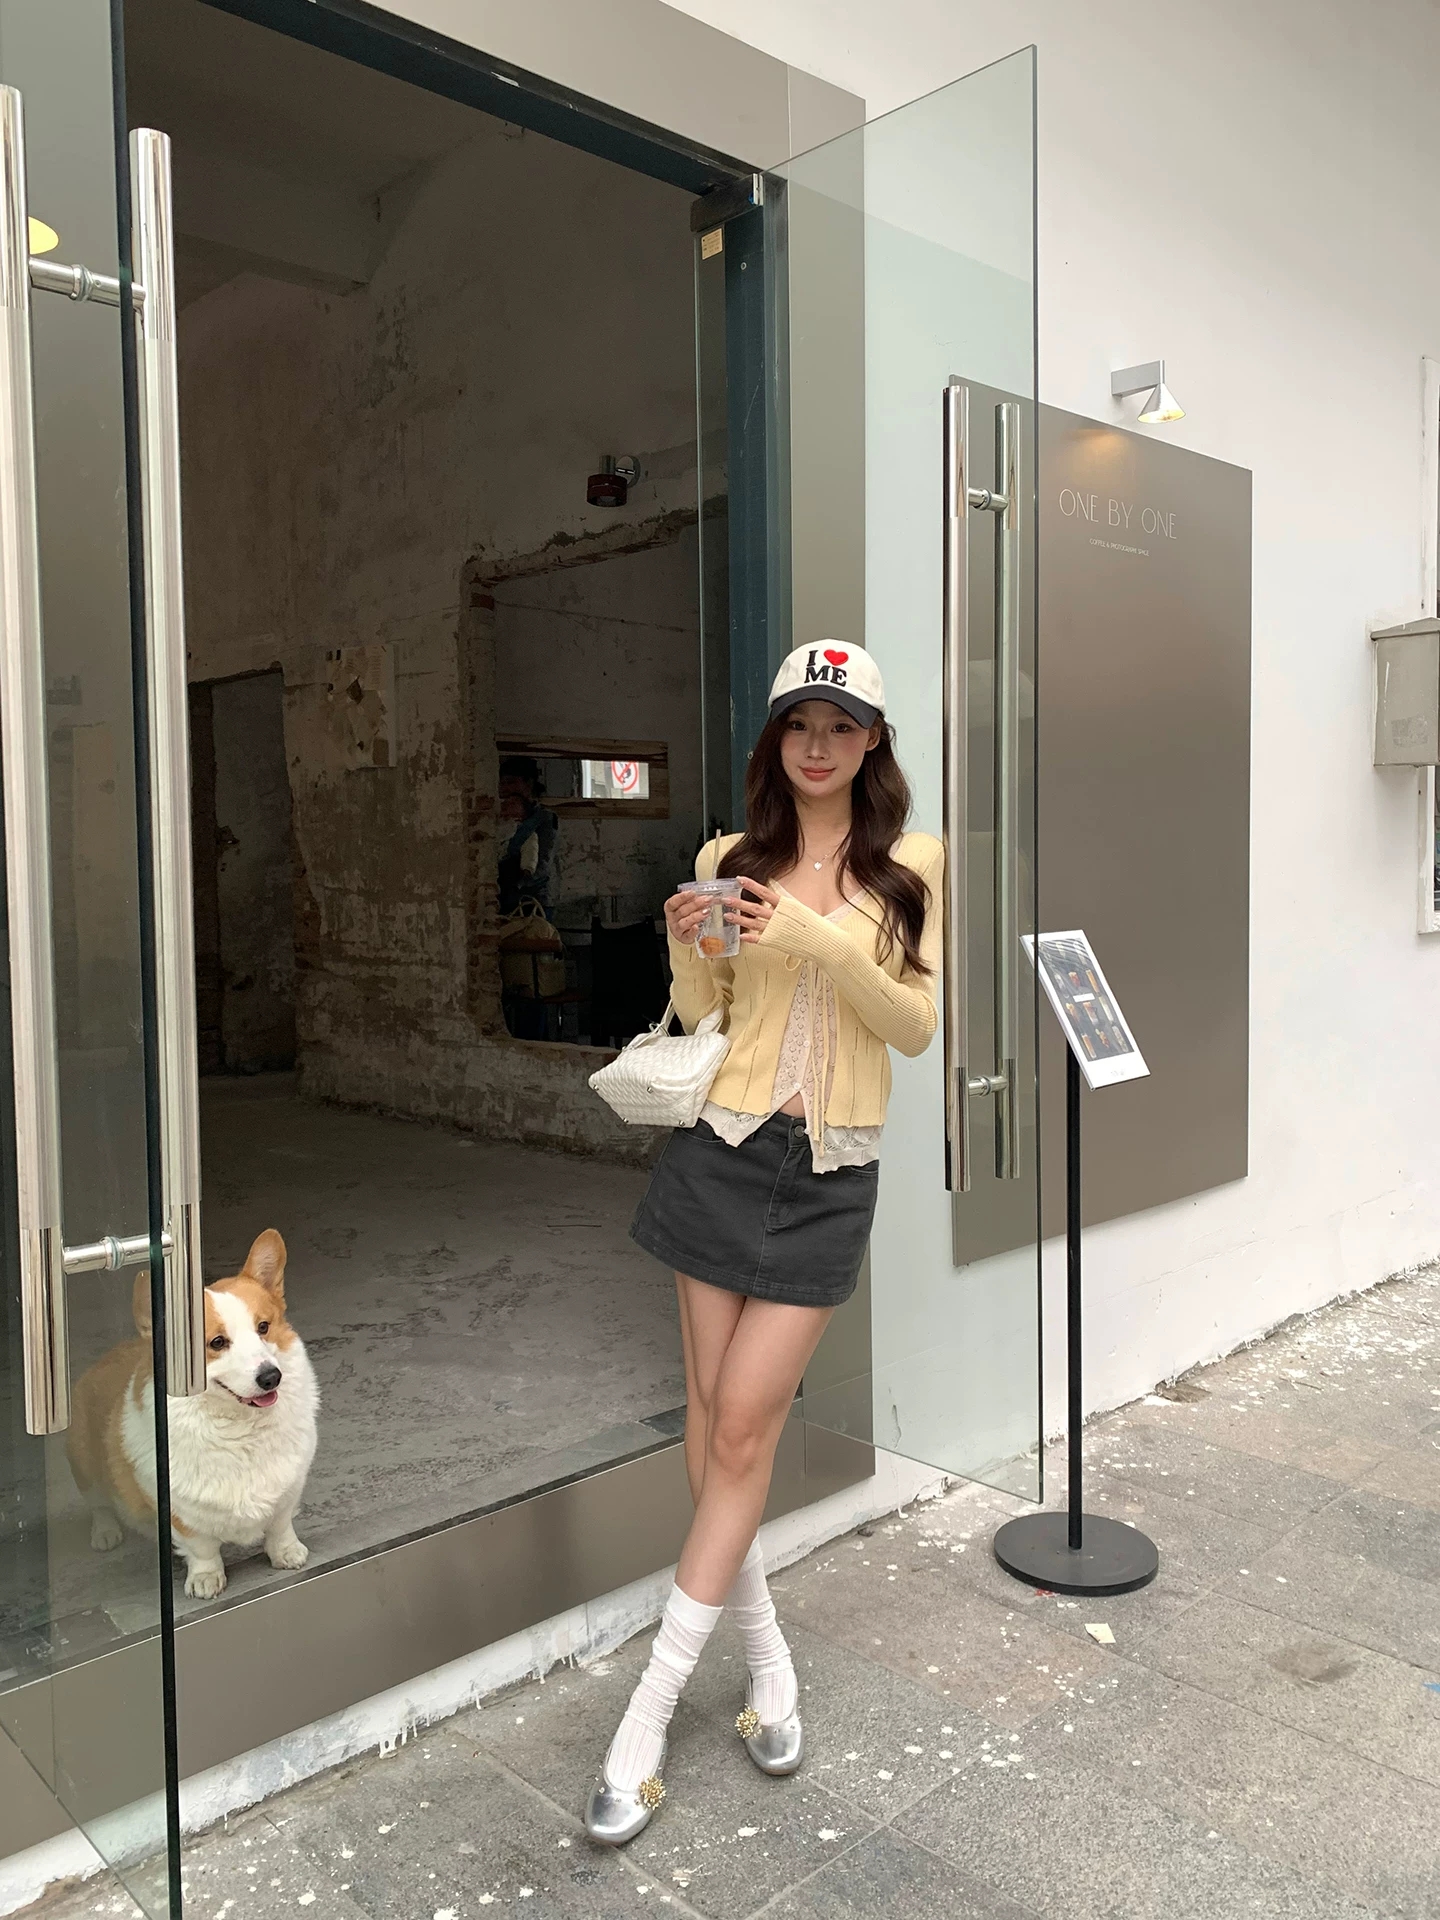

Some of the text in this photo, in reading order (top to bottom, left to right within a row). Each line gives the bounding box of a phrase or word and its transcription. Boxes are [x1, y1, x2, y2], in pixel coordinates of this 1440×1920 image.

[1059, 488, 1177, 540] ONE BY ONE
[806, 649, 819, 667] I
[803, 665, 848, 687] ME
